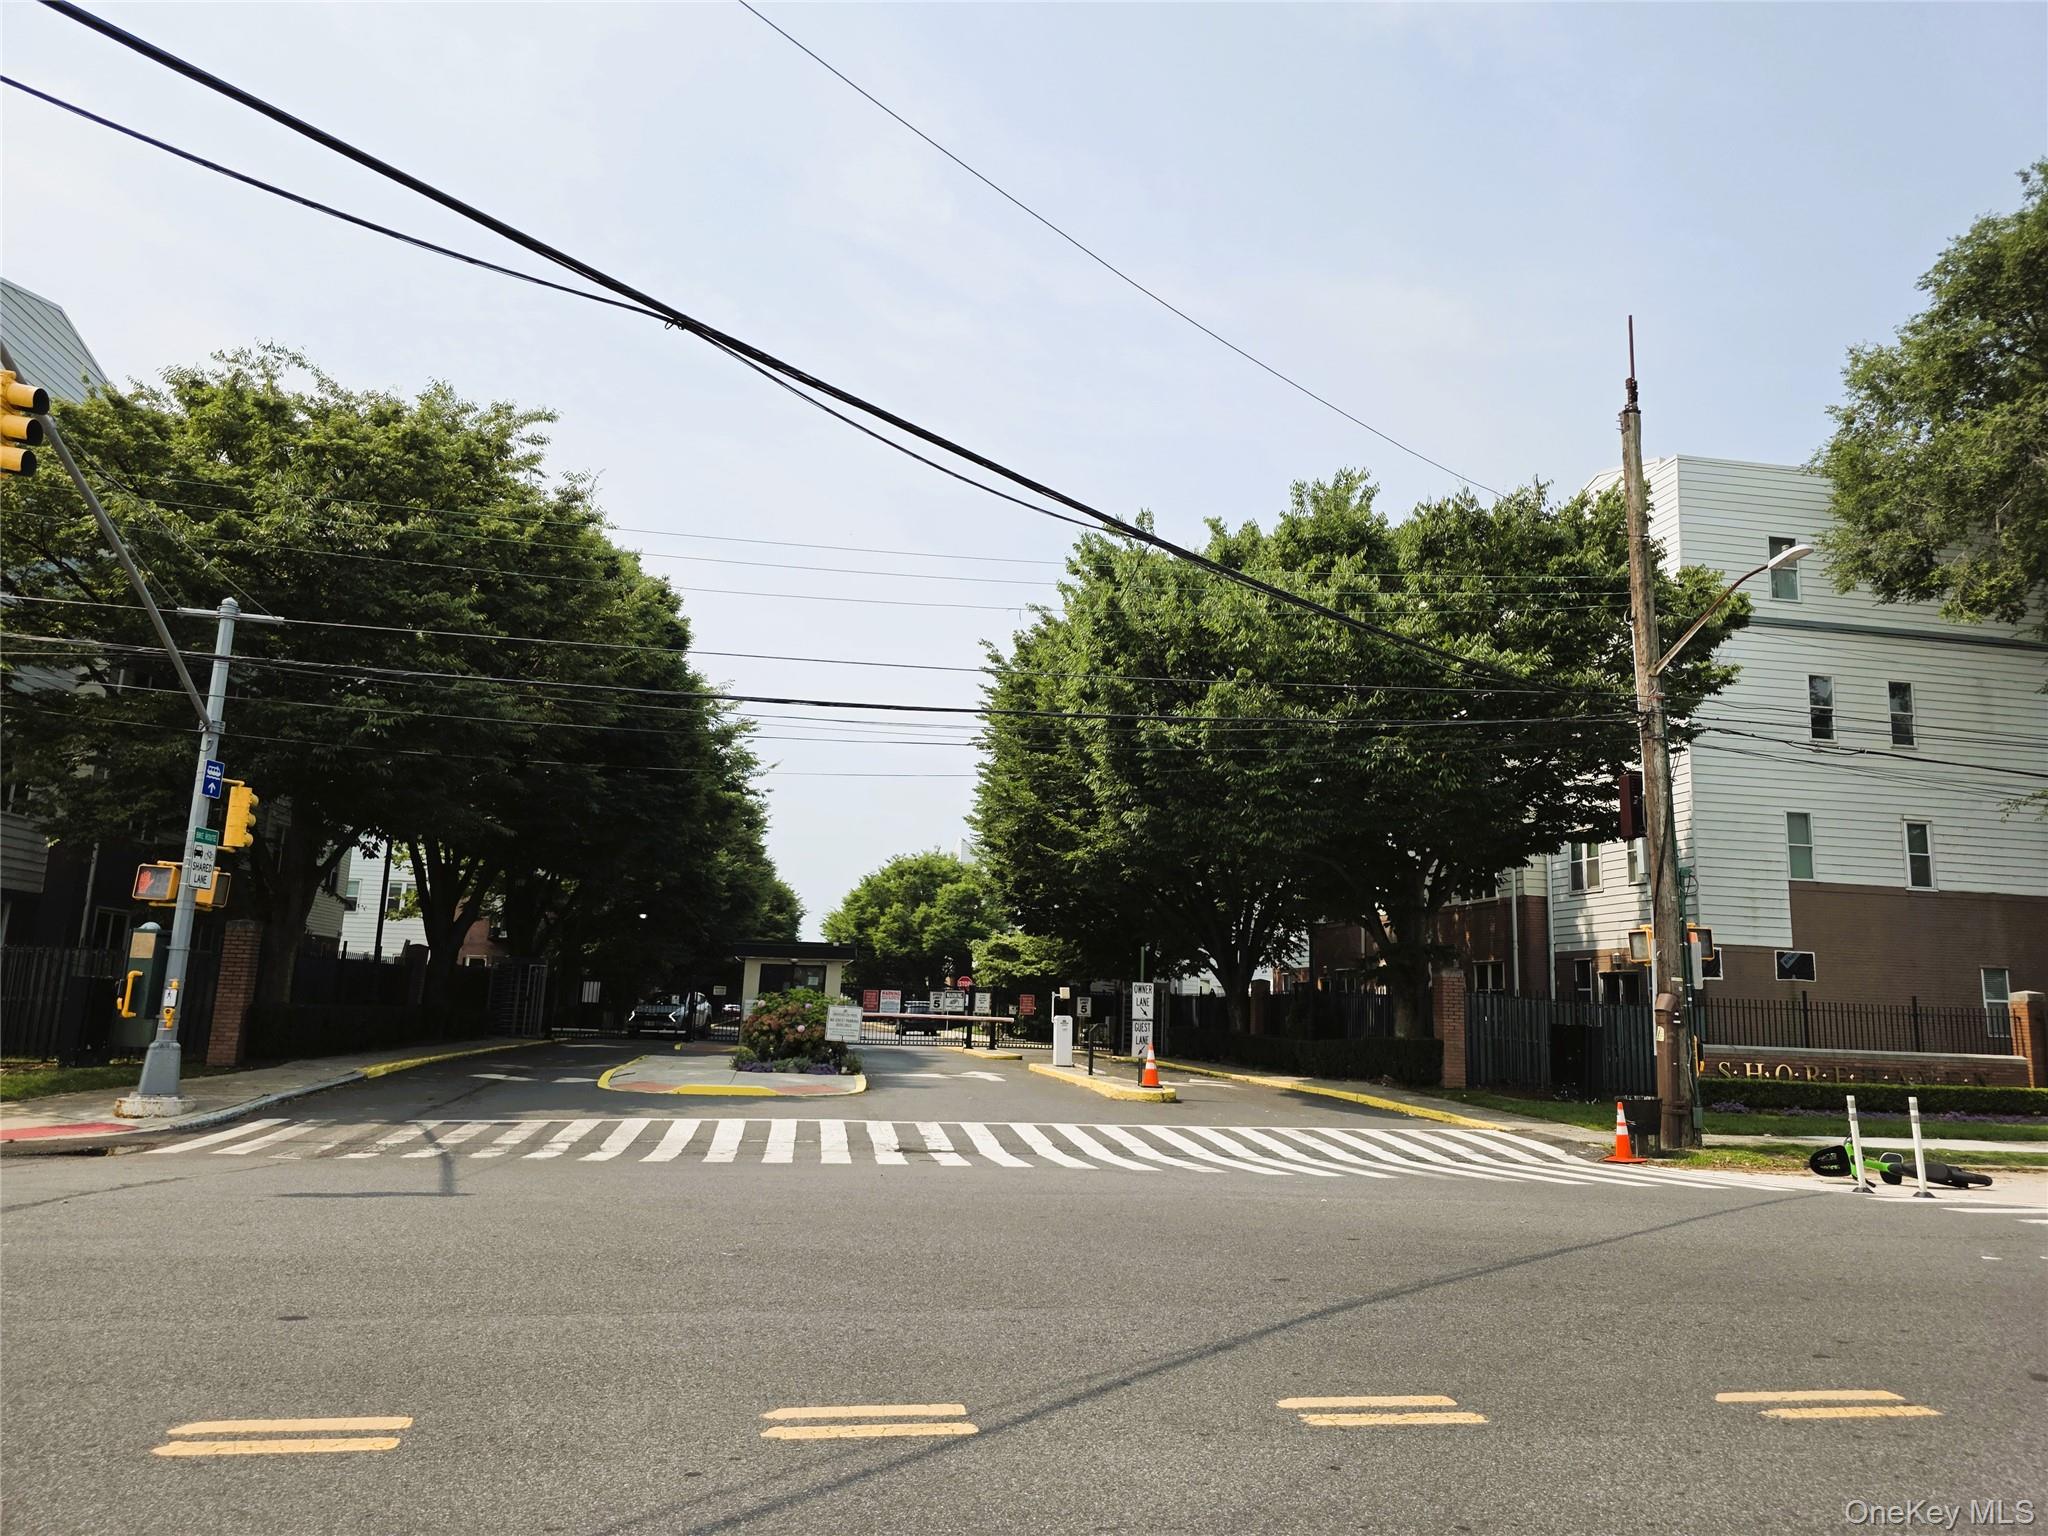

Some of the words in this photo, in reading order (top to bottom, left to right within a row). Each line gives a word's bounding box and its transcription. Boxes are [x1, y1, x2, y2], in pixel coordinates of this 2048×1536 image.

[196, 831, 204, 839] BIKE
[205, 833, 217, 842] ROUTE
[192, 861, 212, 872] SHARED
[193, 873, 208, 884] LANE
[1133, 984, 1153, 994] OWNER
[933, 1000, 941, 1008] 5
[1135, 997, 1150, 1007] LANE
[1081, 1005, 1088, 1013] 5
[1134, 1022, 1151, 1032] GUEST
[1135, 1035, 1149, 1045] LANE
